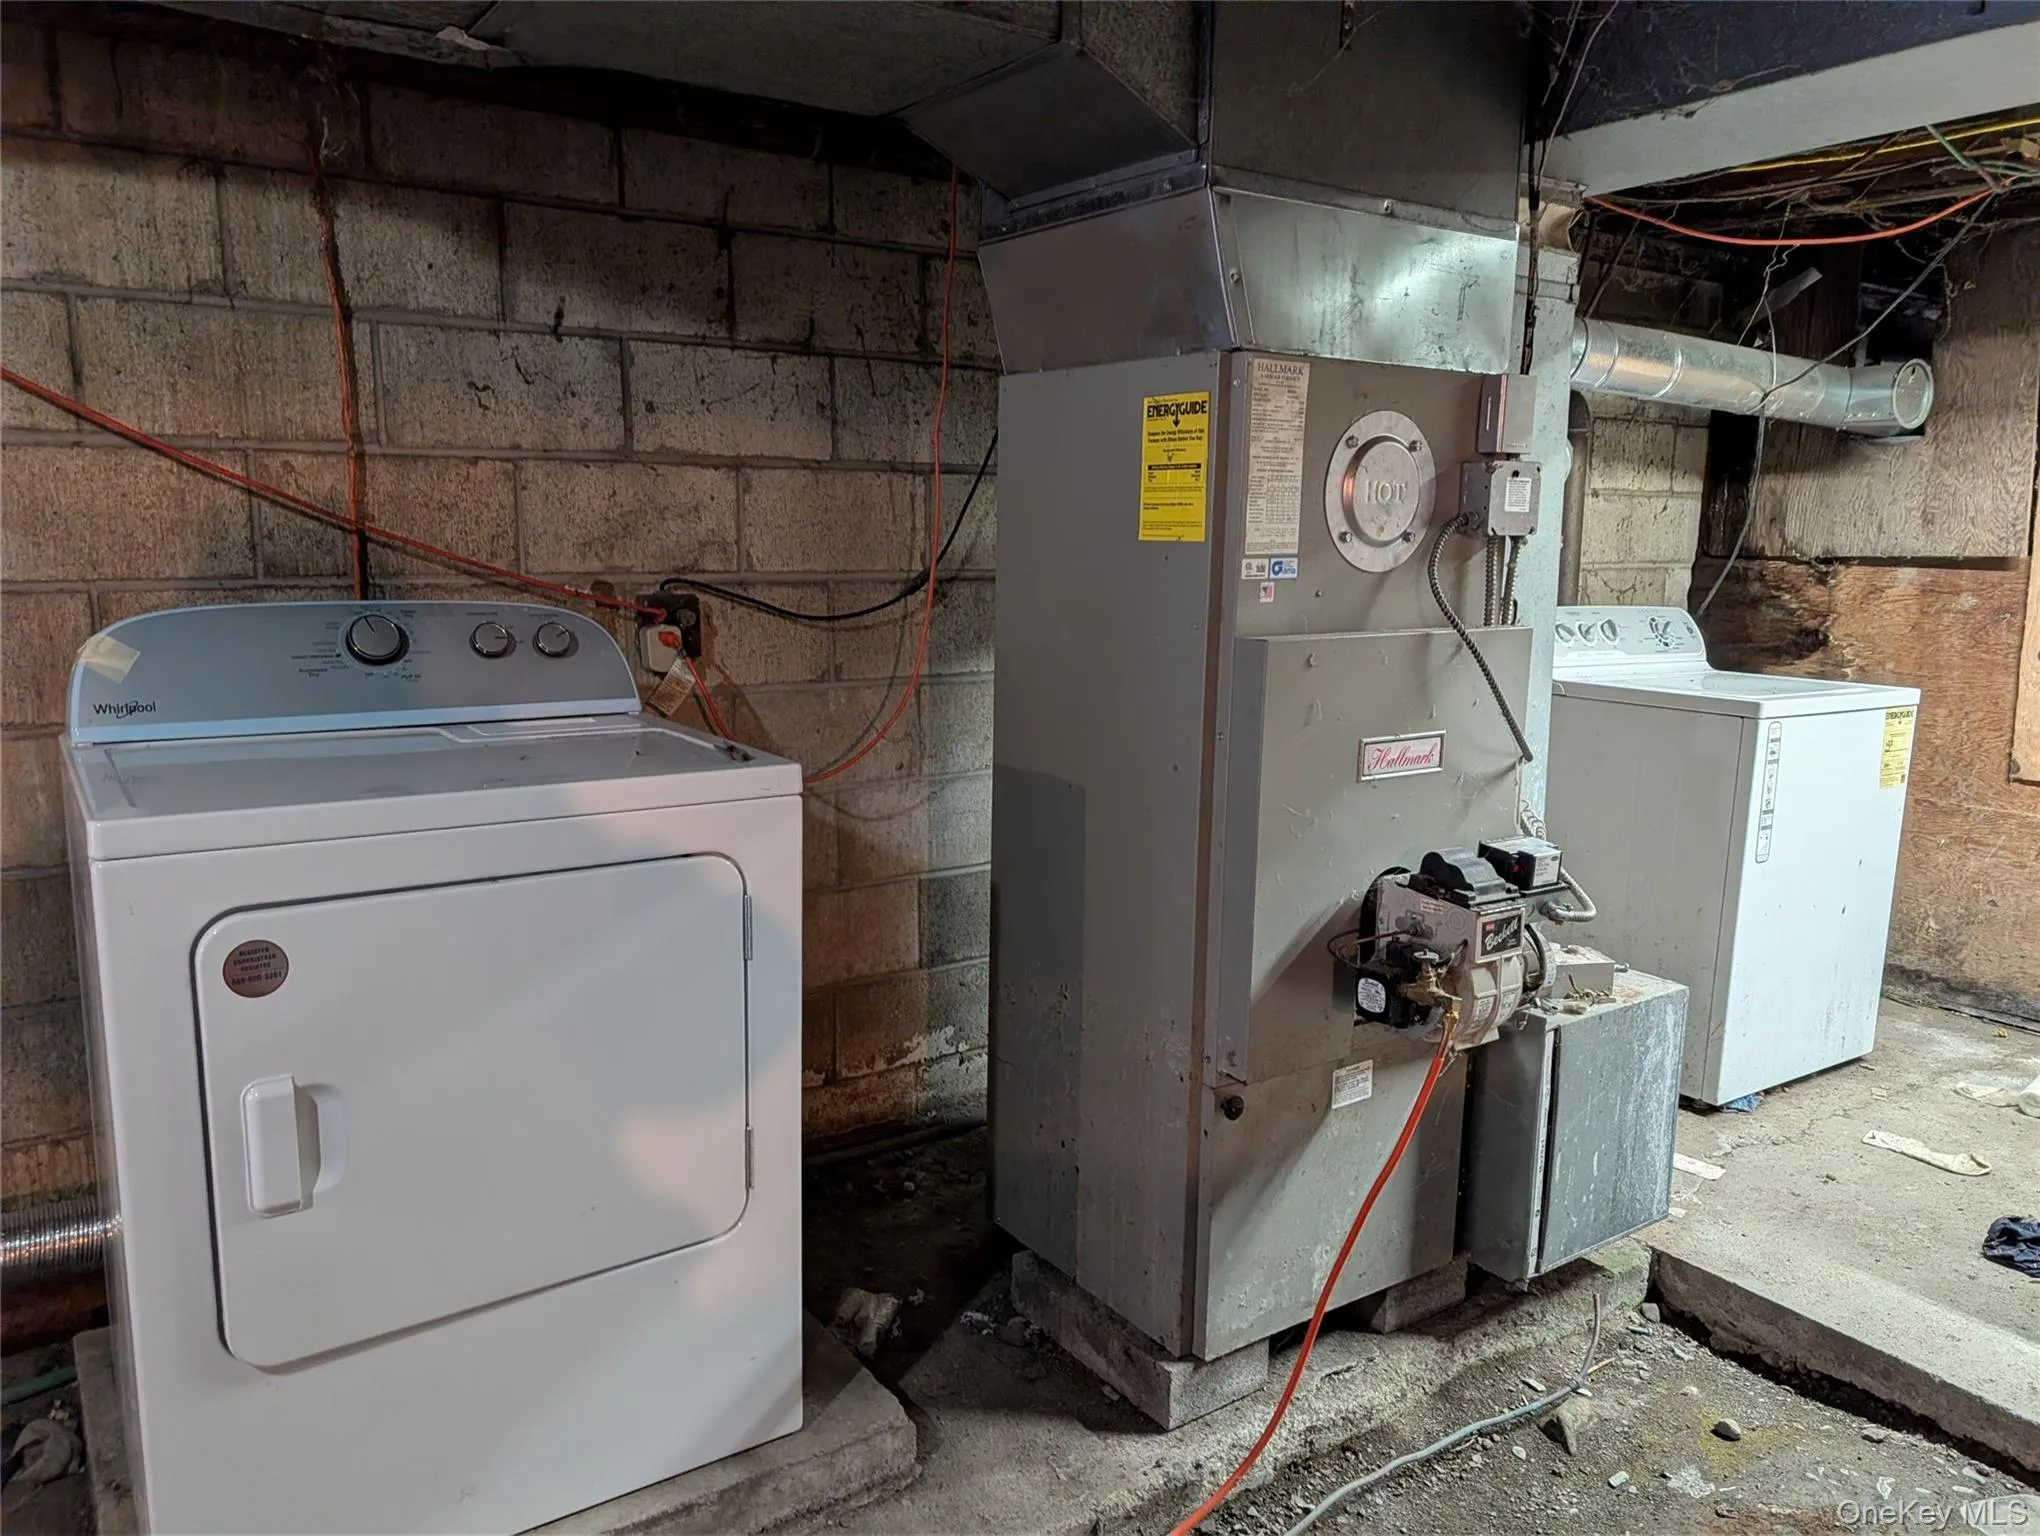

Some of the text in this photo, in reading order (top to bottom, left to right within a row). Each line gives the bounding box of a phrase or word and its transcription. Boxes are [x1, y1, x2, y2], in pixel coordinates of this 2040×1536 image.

[1258, 362, 1304, 376] HALLMARK
[1364, 479, 1408, 505] HOT
[92, 700, 157, 719] Whirlpool
[1367, 742, 1438, 771] Hallmark
[1485, 916, 1519, 951] Beckett
